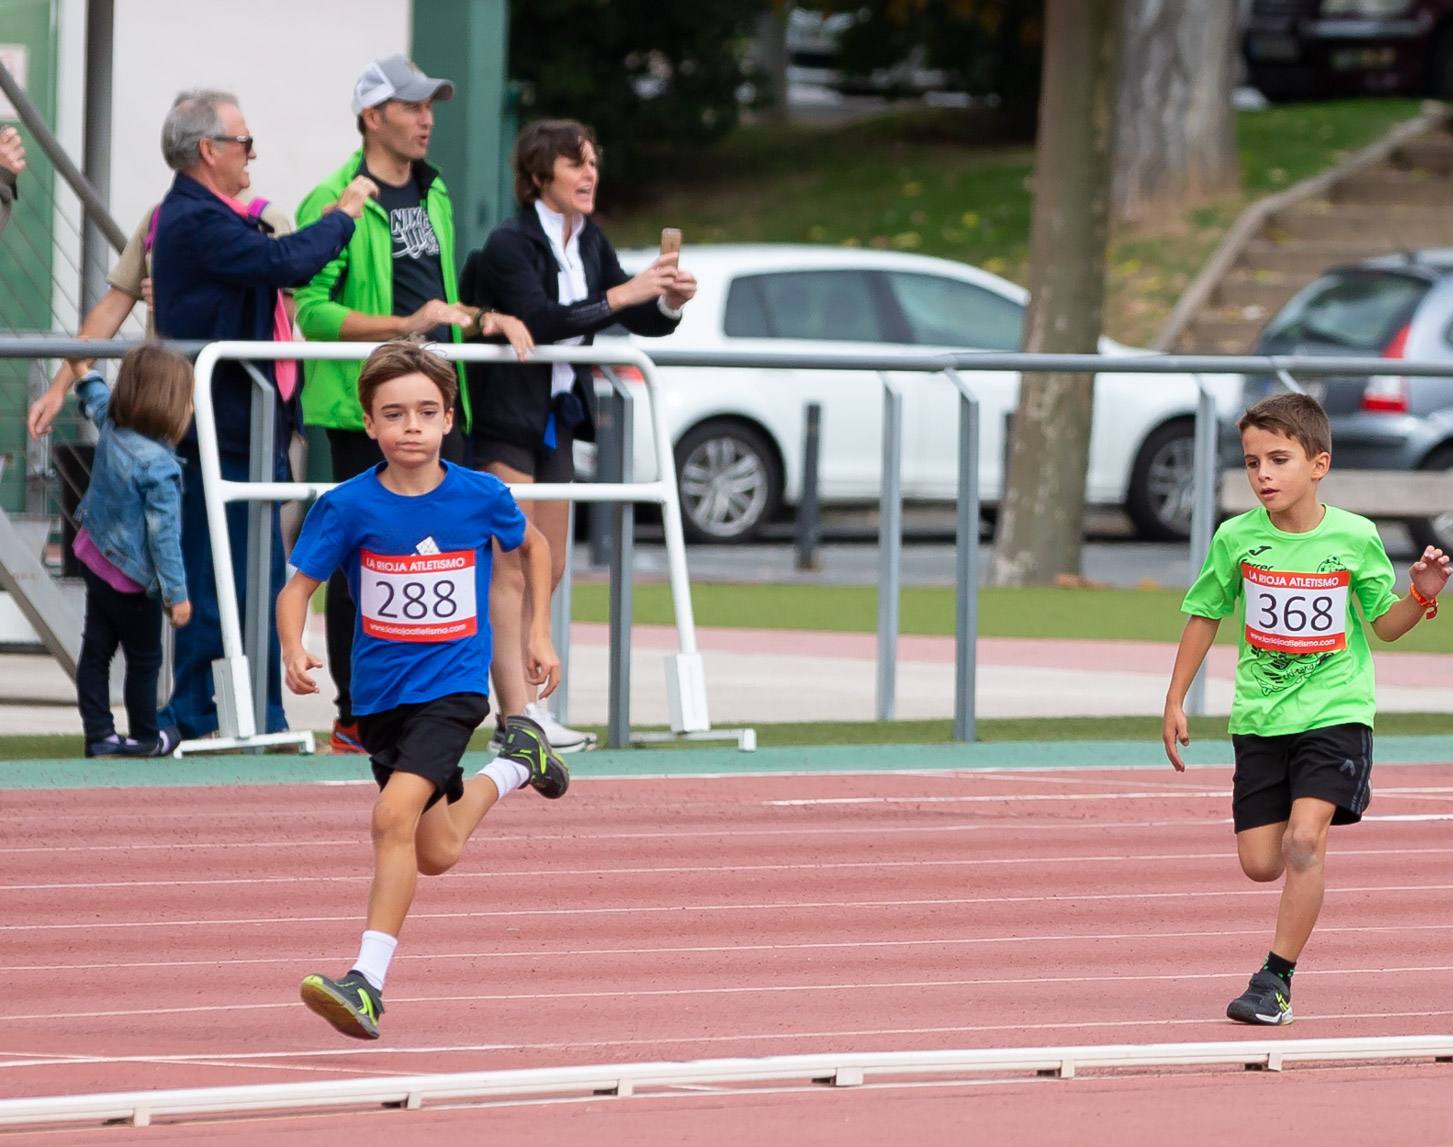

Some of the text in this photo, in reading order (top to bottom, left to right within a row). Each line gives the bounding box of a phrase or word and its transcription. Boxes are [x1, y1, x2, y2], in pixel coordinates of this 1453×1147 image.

[366, 557, 465, 572] LA RIOJA ATLETISMO
[1248, 570, 1339, 587] LA RIOJA ATLETISMO
[375, 580, 457, 619] 288
[1258, 593, 1333, 631] 368
